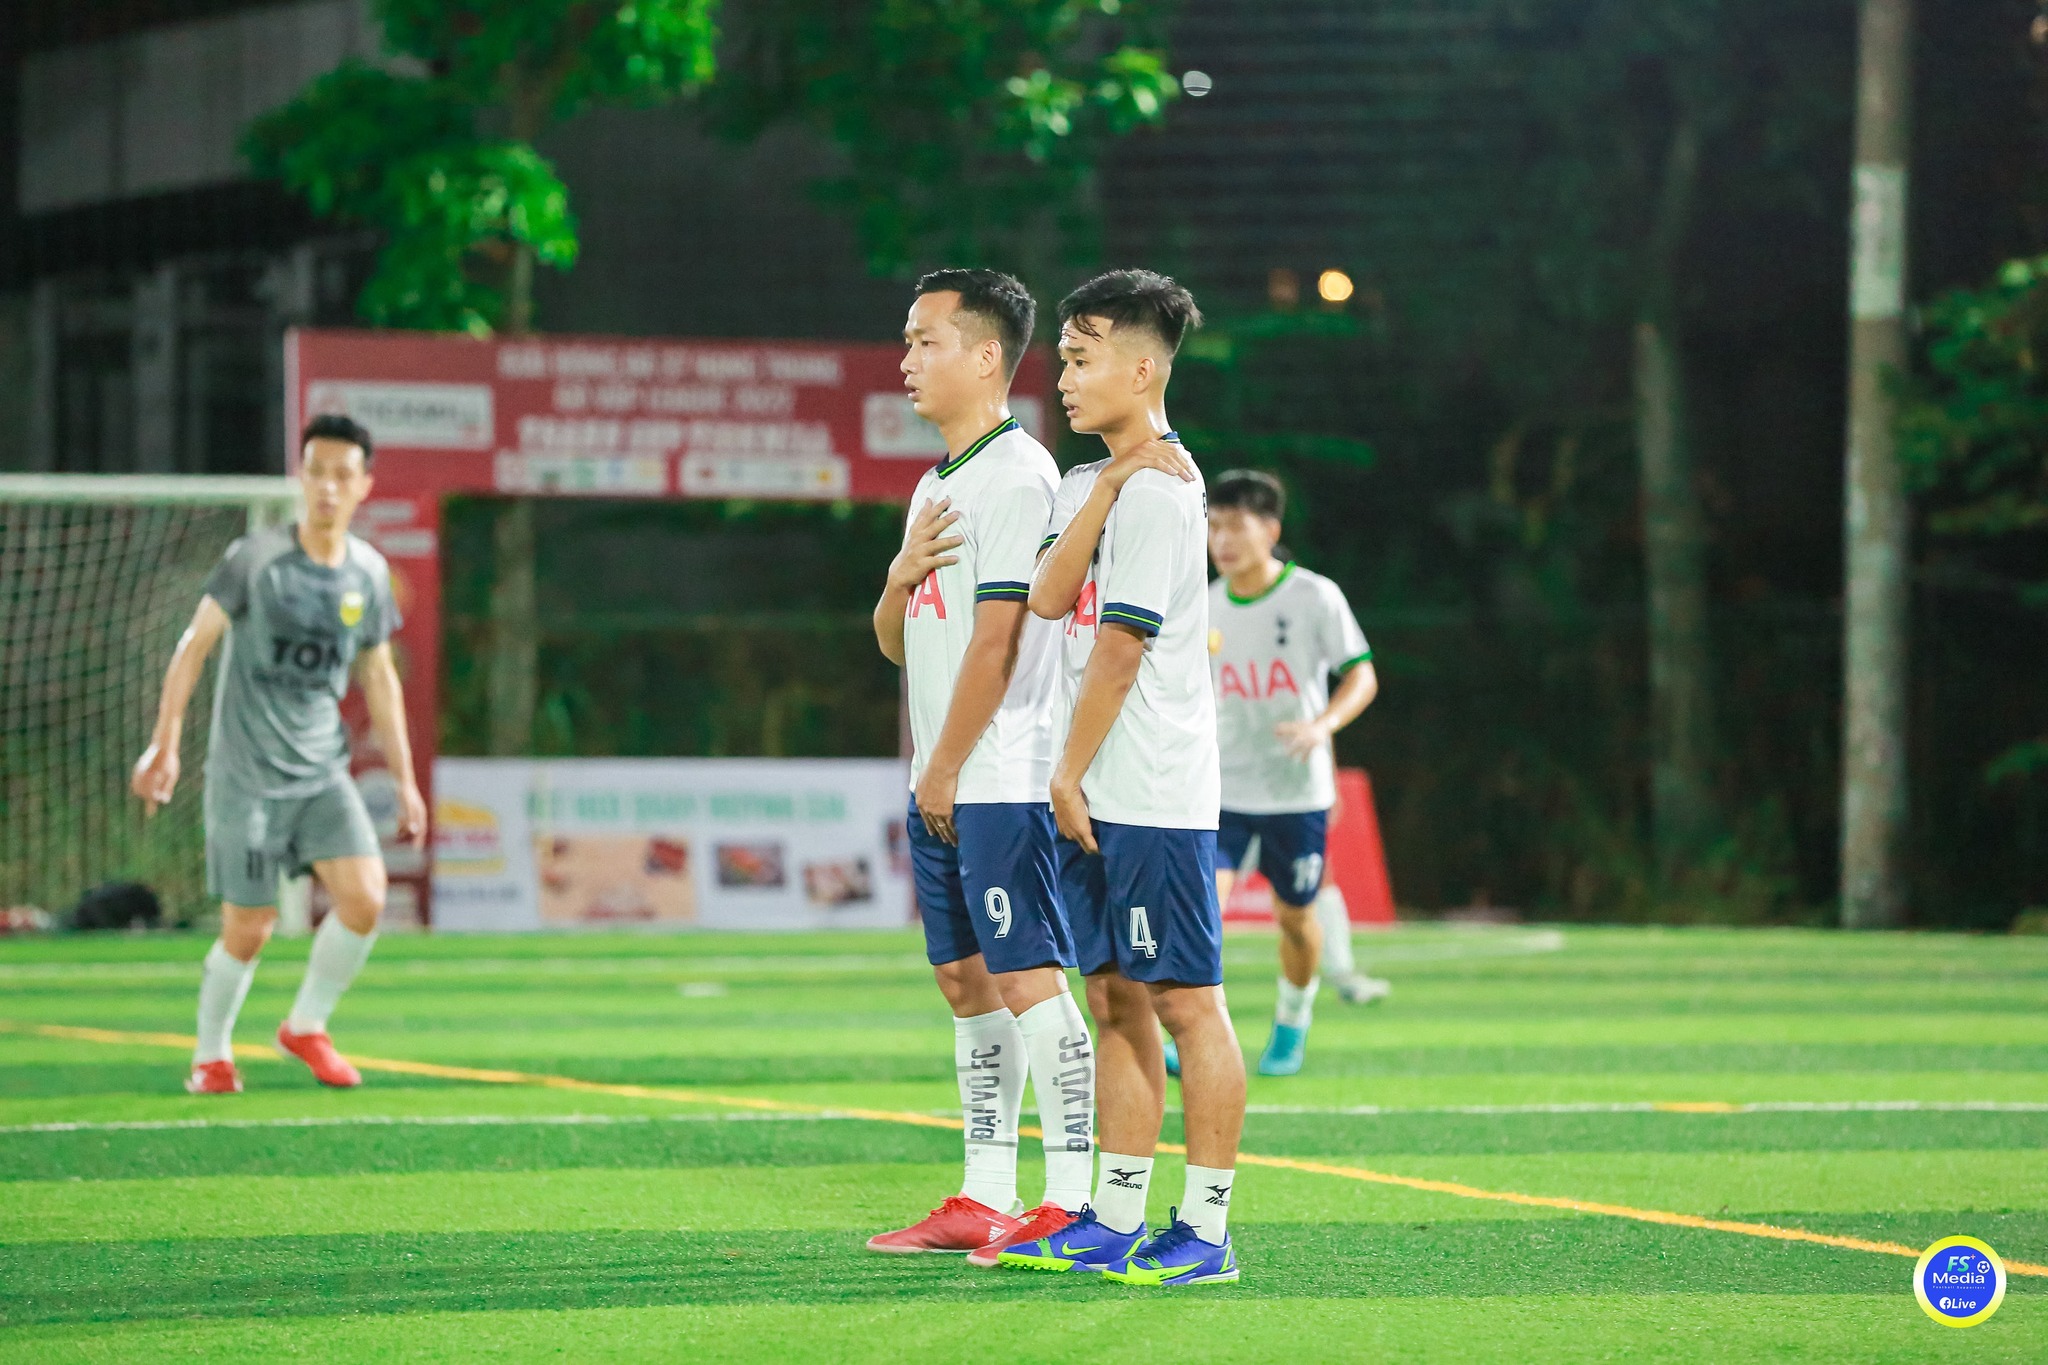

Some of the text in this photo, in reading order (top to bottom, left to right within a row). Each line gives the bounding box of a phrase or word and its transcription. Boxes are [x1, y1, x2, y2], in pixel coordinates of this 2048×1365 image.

[1221, 658, 1300, 699] AIA
[983, 886, 1012, 939] 9
[1129, 906, 1158, 959] 4
[970, 1044, 1002, 1070] FC
[1058, 1032, 1090, 1064] FC
[1052, 1066, 1092, 1106] VŨ
